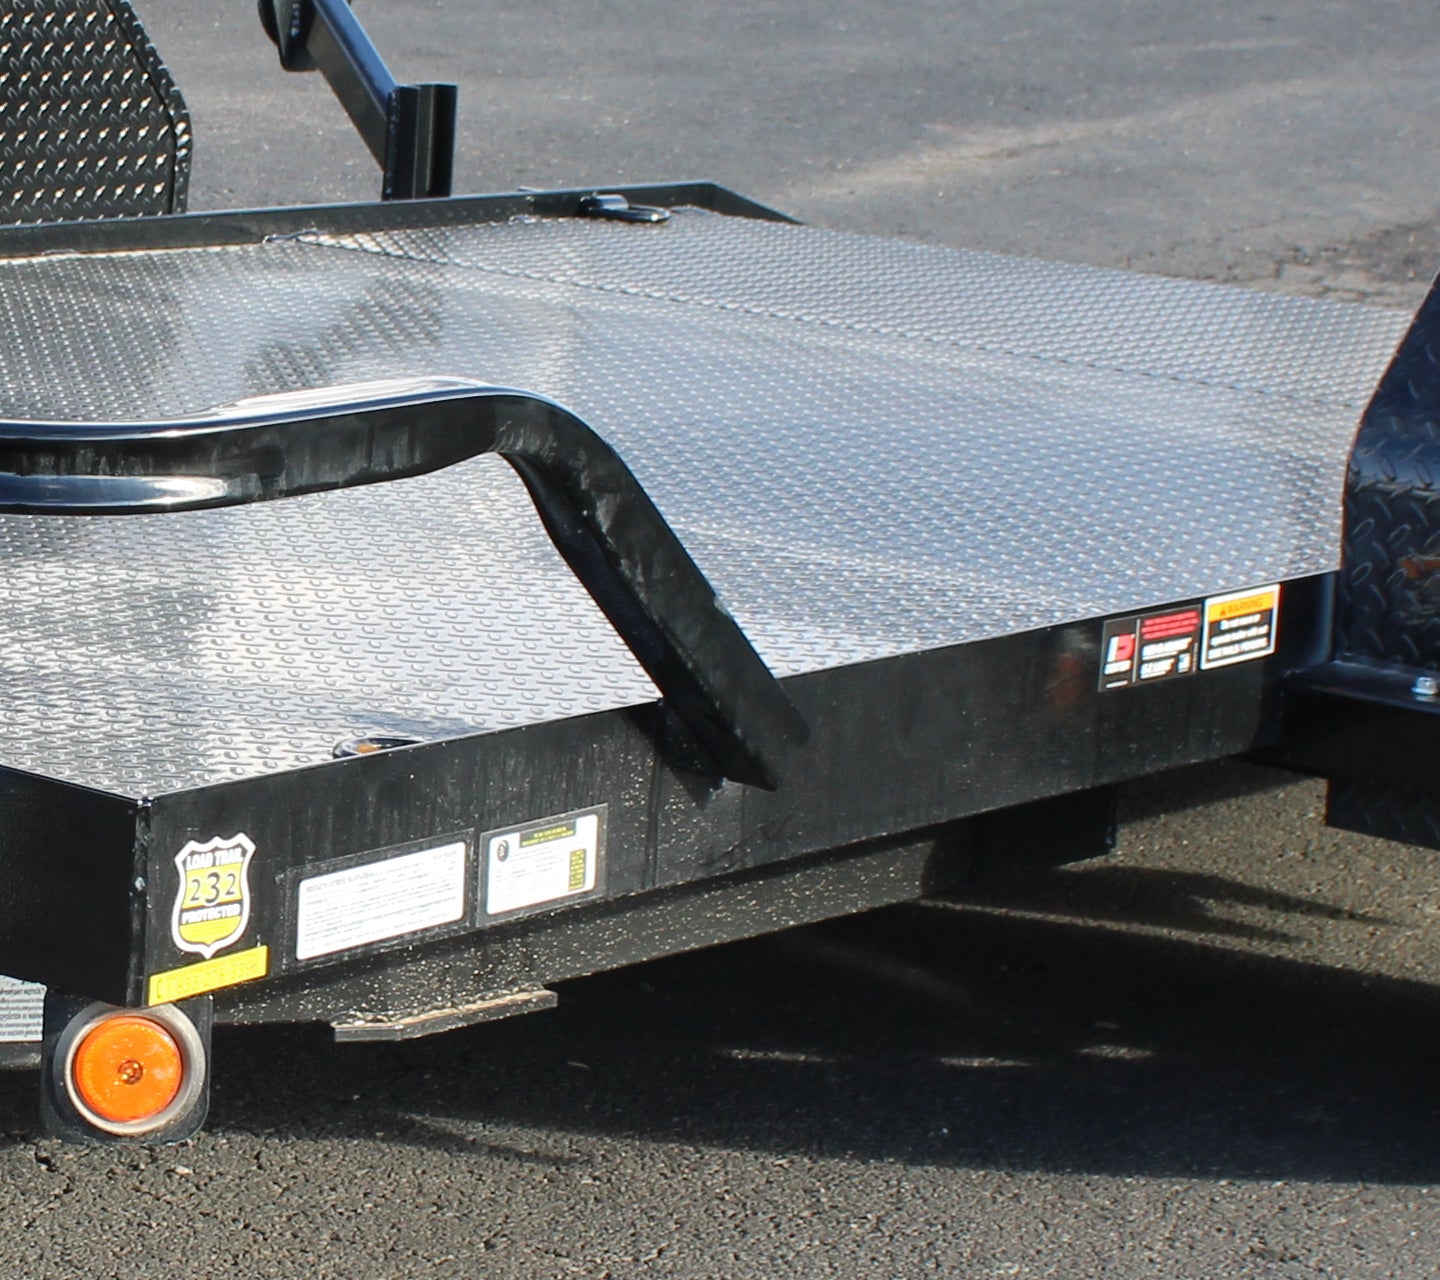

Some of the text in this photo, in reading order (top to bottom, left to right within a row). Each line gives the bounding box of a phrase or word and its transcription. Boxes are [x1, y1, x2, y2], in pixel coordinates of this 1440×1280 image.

[186, 847, 244, 870] LOAD TRAIL
[181, 903, 241, 925] PROTECTED
